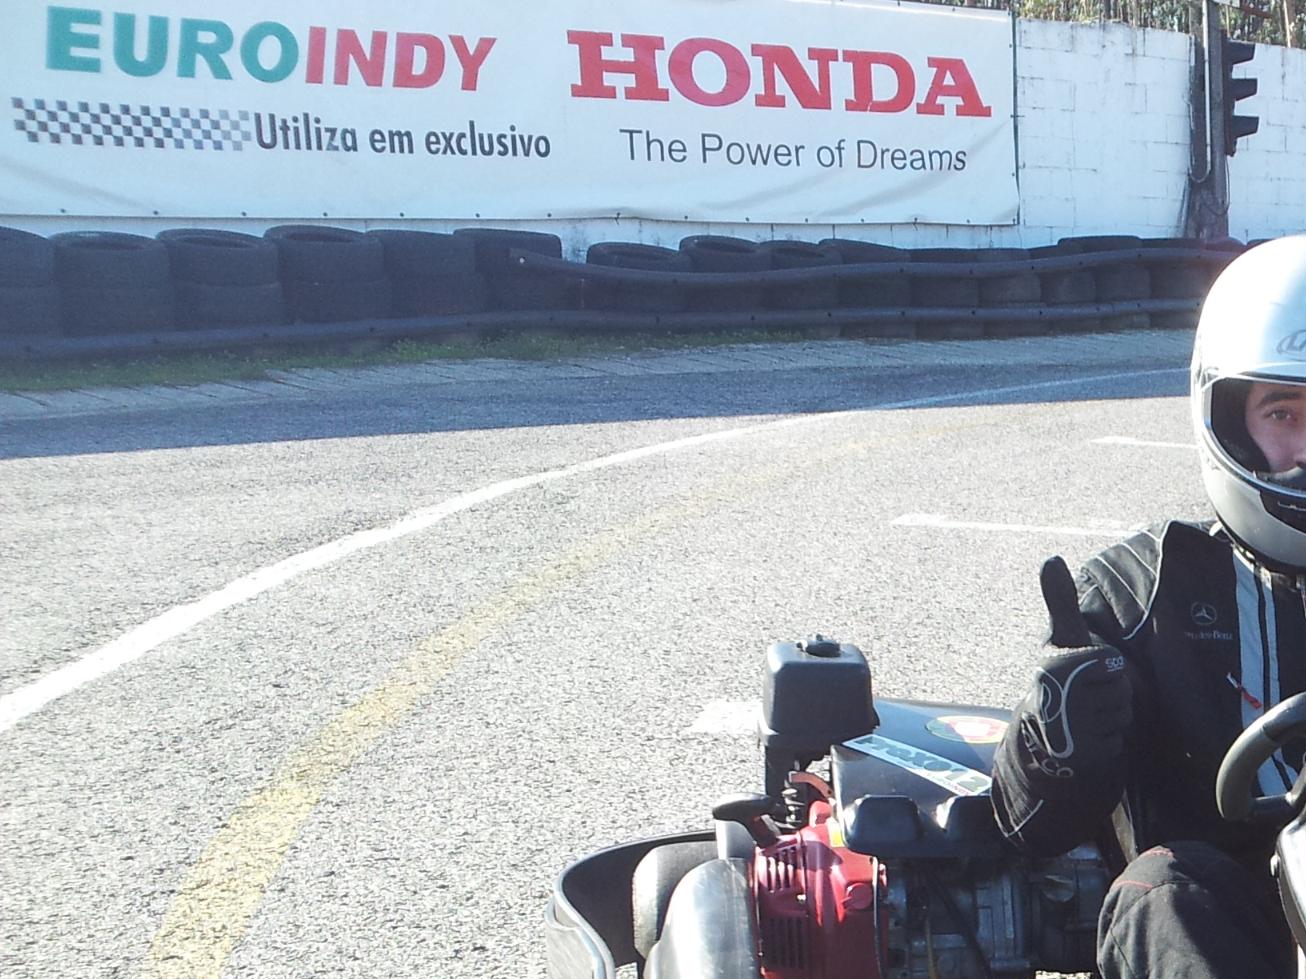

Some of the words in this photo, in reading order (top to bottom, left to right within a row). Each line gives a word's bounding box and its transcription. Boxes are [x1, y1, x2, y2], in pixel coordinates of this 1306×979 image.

[45, 6, 497, 92] EUROINDY
[567, 29, 992, 118] HONDA
[254, 112, 358, 153] Utiliza
[369, 129, 414, 156] em
[425, 121, 551, 160] exclusivo
[620, 129, 687, 164] The
[701, 133, 805, 168] Power
[817, 138, 846, 169] of
[856, 139, 967, 172] Dreams
